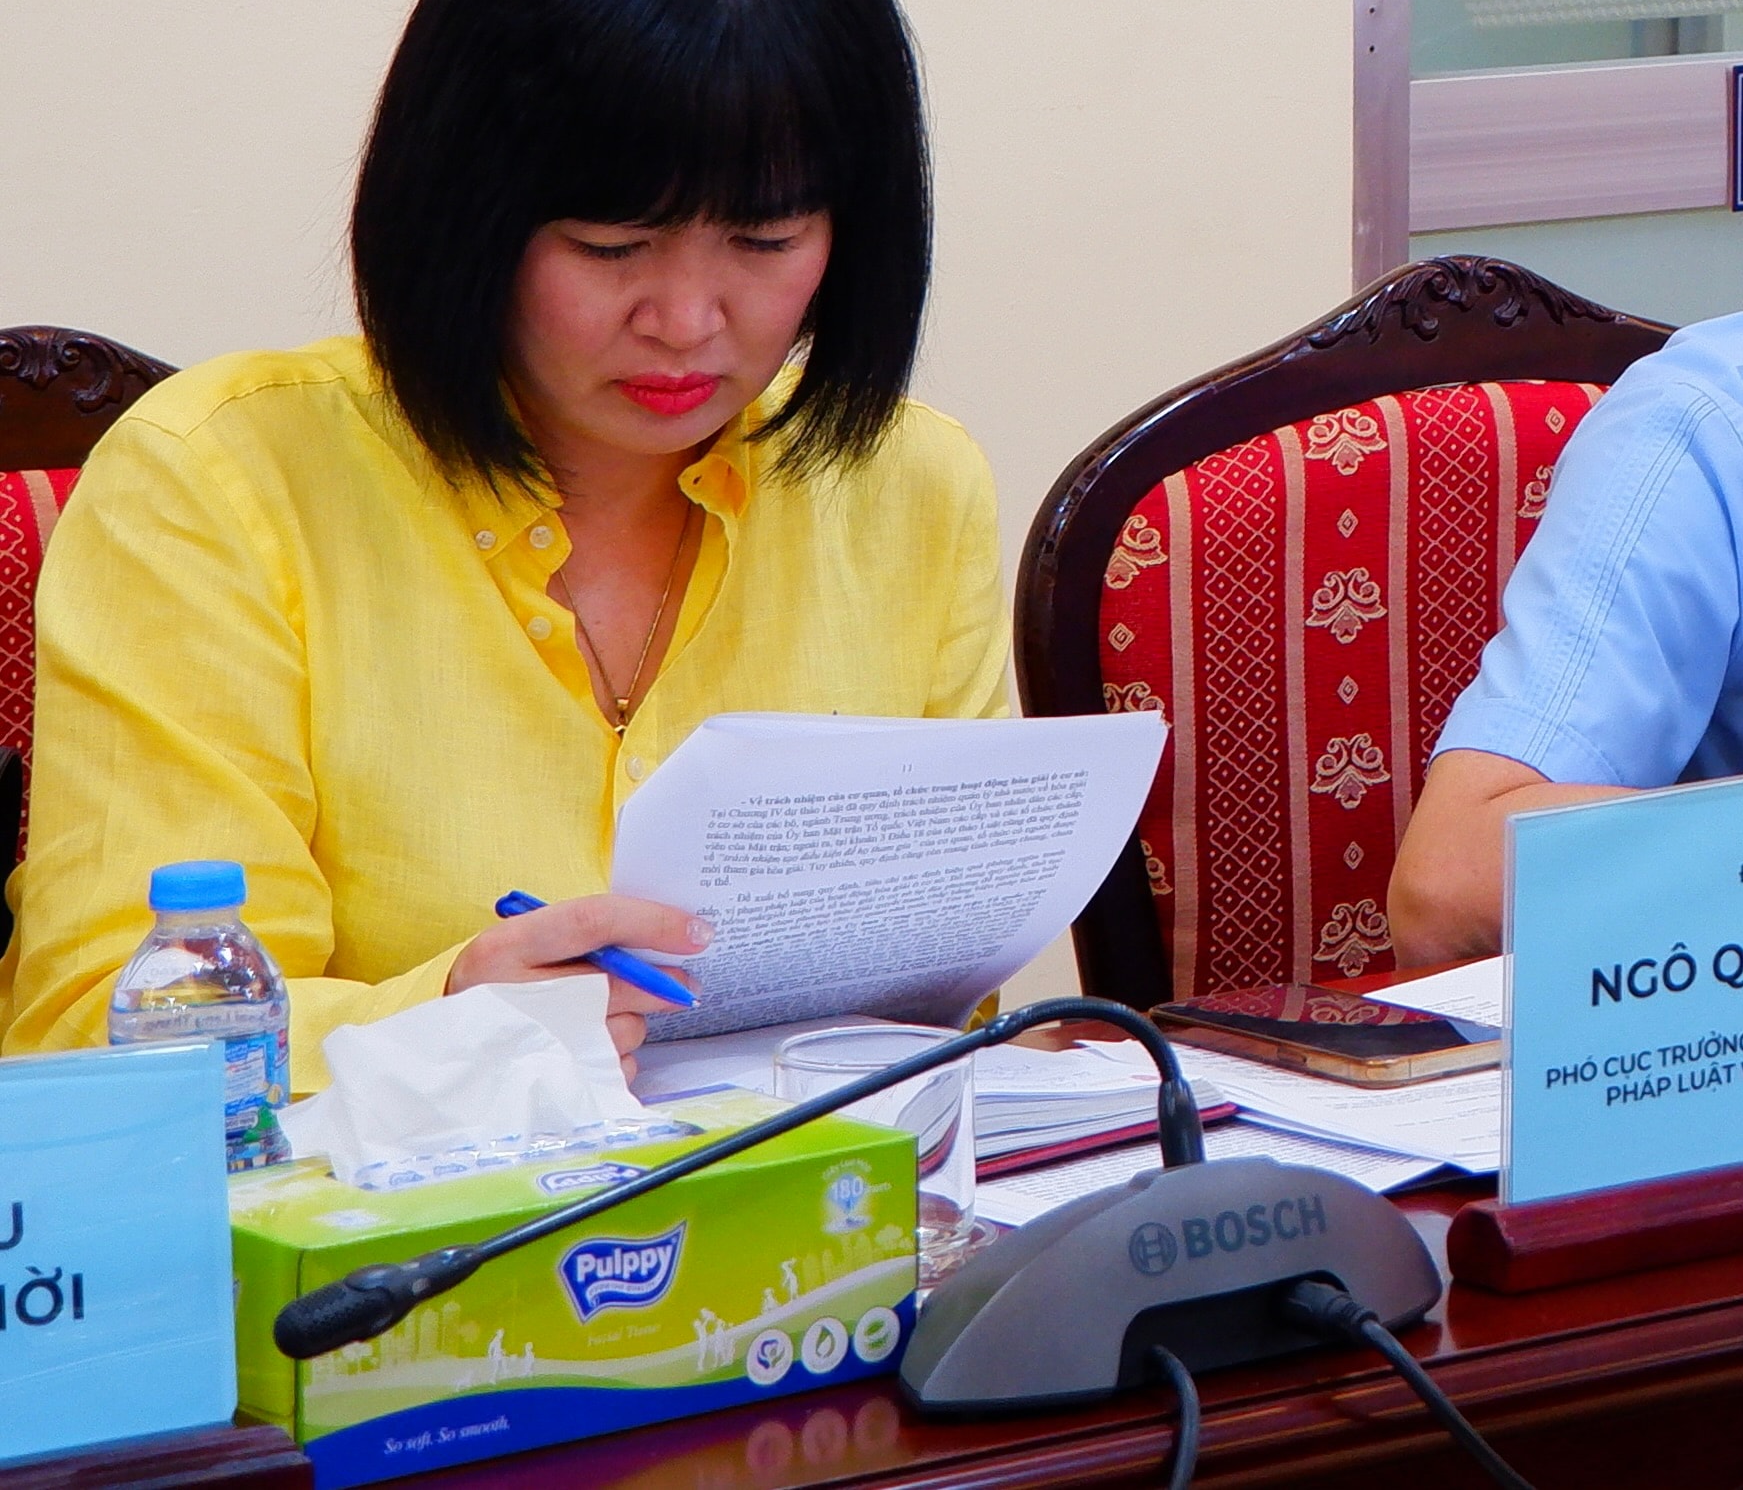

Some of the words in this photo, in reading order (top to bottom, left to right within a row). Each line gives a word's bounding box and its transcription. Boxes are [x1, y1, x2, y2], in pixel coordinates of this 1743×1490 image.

[1591, 942, 1697, 1006] NGÔ
[1546, 1055, 1598, 1089] PHÓ
[1603, 1050, 1652, 1079] CỤC
[1606, 1075, 1671, 1106] PHÁP
[1678, 1062, 1737, 1093] LUẬT
[1181, 1193, 1327, 1259] BOSCH
[576, 1244, 677, 1284] Pulppy
[0, 1266, 85, 1332] ỜI
